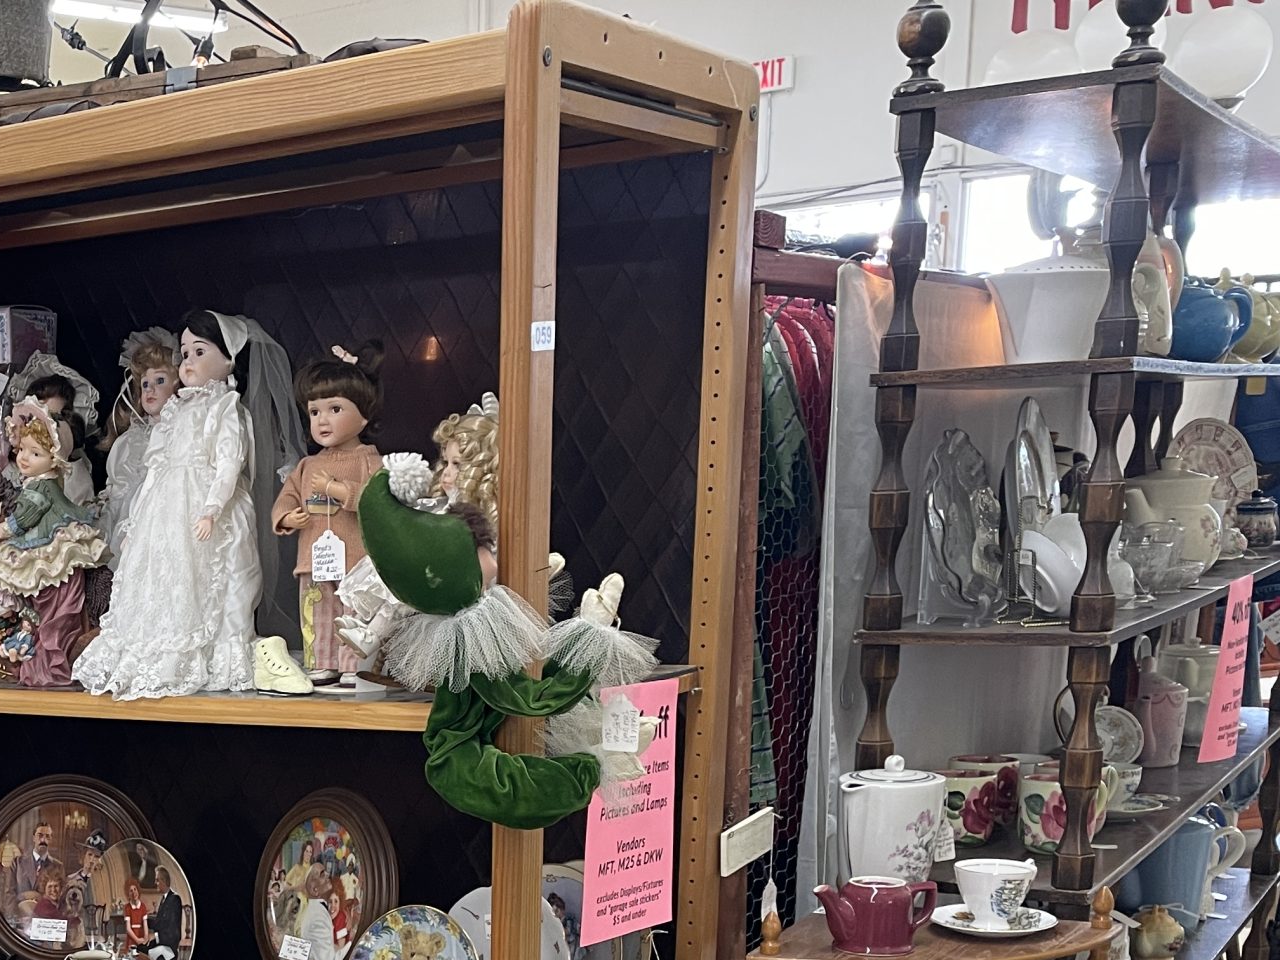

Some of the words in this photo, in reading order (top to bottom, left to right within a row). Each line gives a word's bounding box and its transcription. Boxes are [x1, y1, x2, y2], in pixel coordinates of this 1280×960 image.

[752, 57, 785, 88] XIT
[535, 326, 552, 345] 059
[653, 704, 670, 742] ff
[651, 760, 670, 775] Items
[600, 805, 630, 821] Pictures
[630, 799, 646, 815] and
[646, 797, 668, 811] Lamps
[616, 835, 646, 855] Vendors
[598, 860, 617, 878] MFT,
[618, 855, 635, 873] M25
[636, 854, 642, 866] &
[643, 848, 663, 865] DKW
[596, 889, 620, 904] excludes
[596, 905, 608, 917] and
[628, 896, 639, 910] sale
[612, 914, 621, 926] $5
[621, 911, 631, 923] and
[631, 908, 647, 921] under
